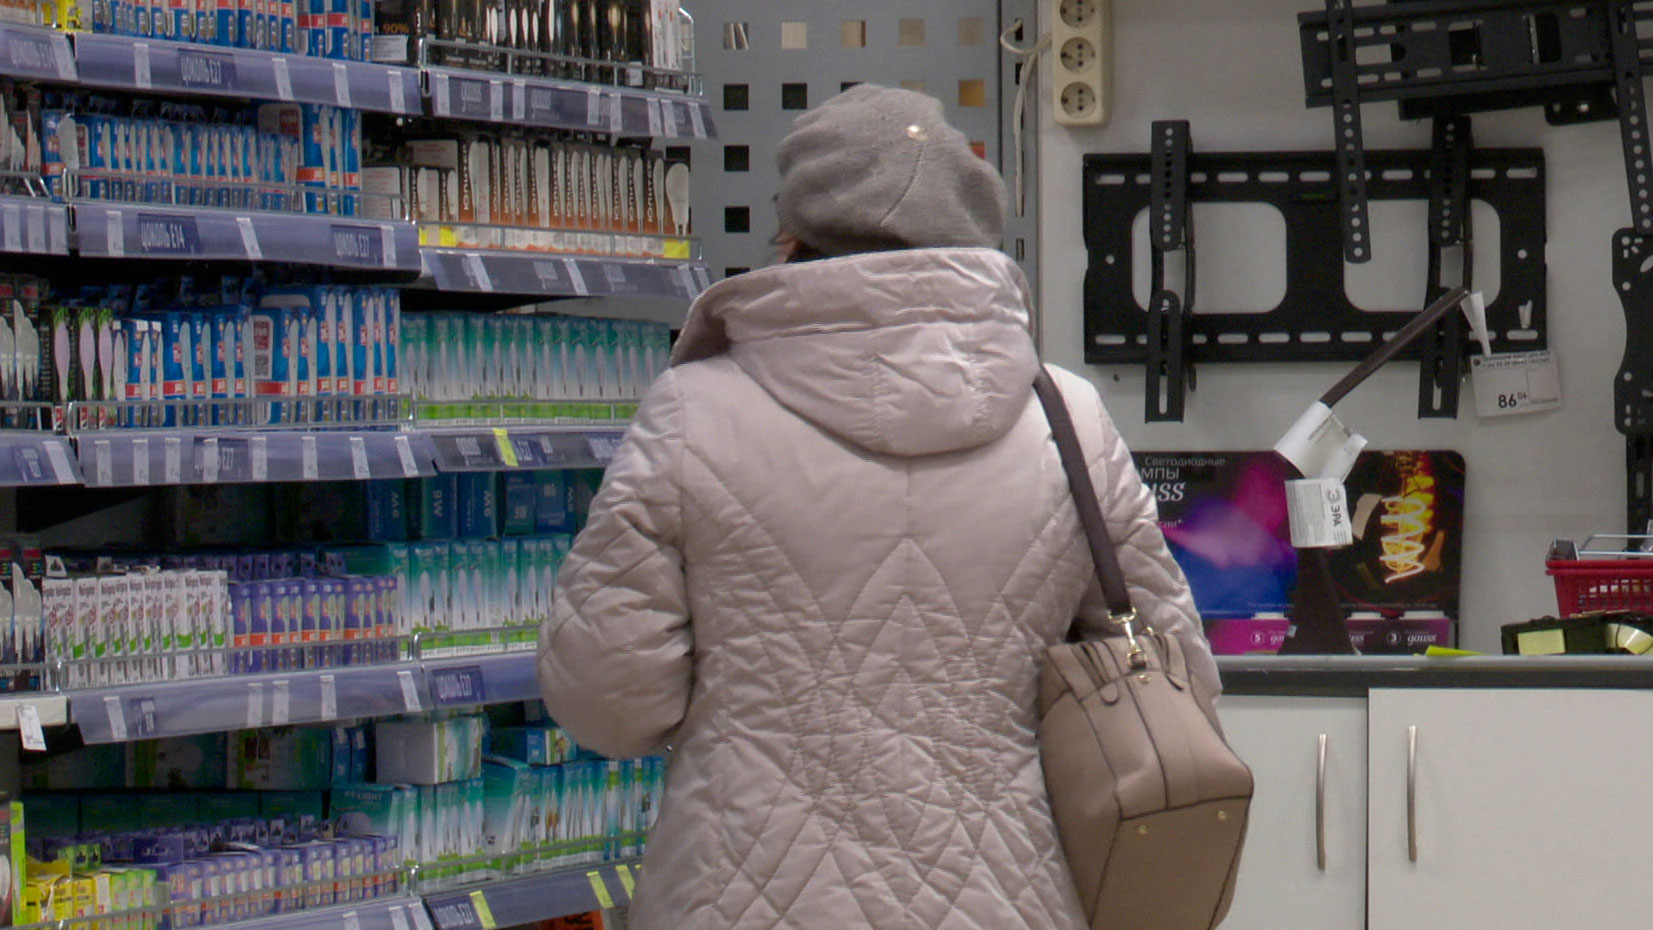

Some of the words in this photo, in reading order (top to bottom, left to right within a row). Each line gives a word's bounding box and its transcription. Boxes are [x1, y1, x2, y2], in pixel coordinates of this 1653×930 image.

[180, 55, 209, 86] ЦОКОЛЬ
[208, 58, 222, 84] E27
[141, 221, 170, 252] ЦОКОЛЬ
[169, 223, 186, 249] E14
[333, 231, 359, 260] ЦОКОЛЬ
[358, 233, 370, 258] E27
[1498, 394, 1517, 409] 86
[1145, 456, 1226, 467] Светодиодные
[1141, 467, 1180, 480] МПЫ
[1330, 504, 1342, 527] ЭРА
[1407, 633, 1437, 646] gauss
